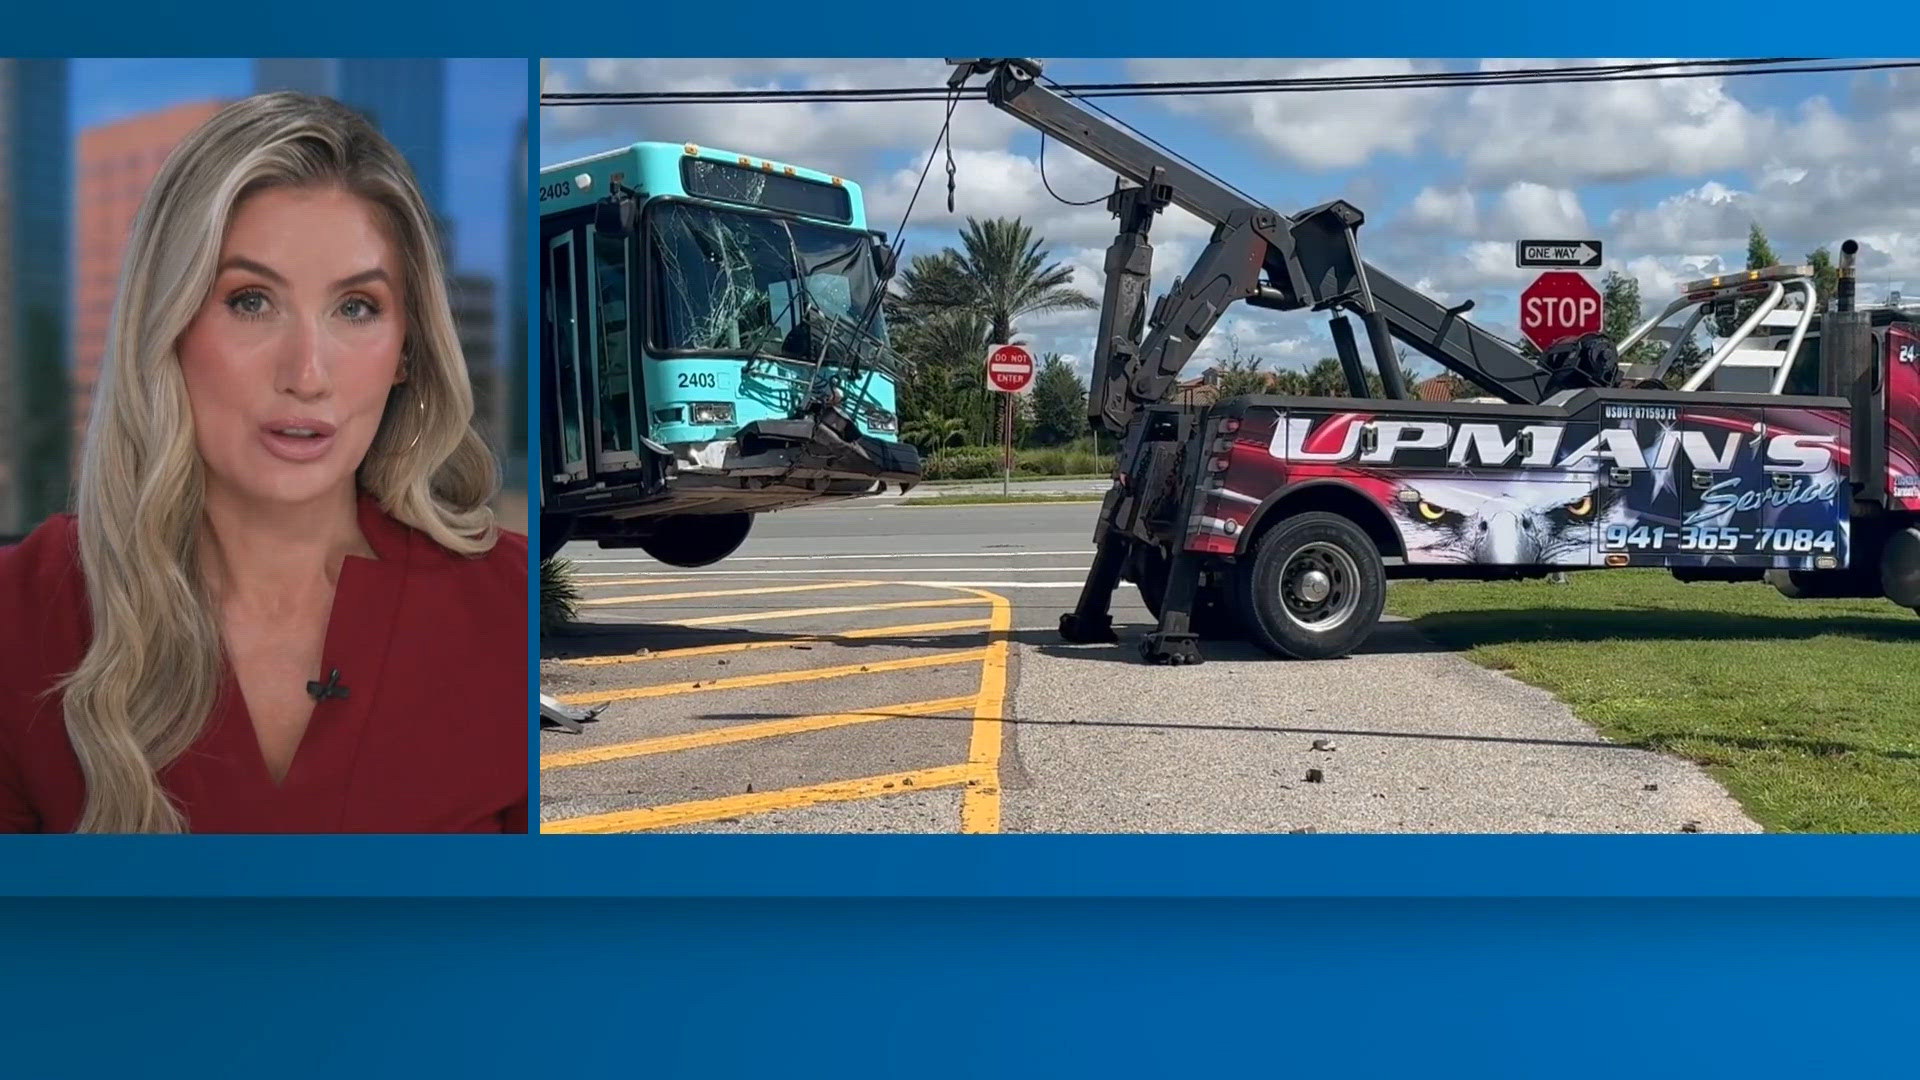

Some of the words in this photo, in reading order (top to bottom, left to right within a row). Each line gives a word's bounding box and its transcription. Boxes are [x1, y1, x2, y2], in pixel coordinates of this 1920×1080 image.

[540, 181, 570, 201] 2403
[1528, 248, 1550, 258] ONE
[1554, 248, 1577, 258] WAY
[1525, 297, 1597, 328] STOP
[1011, 354, 1027, 363] NOT
[678, 373, 716, 388] 2403
[997, 374, 1024, 384] ENTER
[1605, 406, 1633, 419] USDOT
[1635, 407, 1666, 419] 871593
[1668, 408, 1677, 420] FL
[1268, 417, 1838, 475] UPMAN'S
[1684, 477, 1838, 525] Service
[1605, 524, 1835, 552] 941-365-7084
